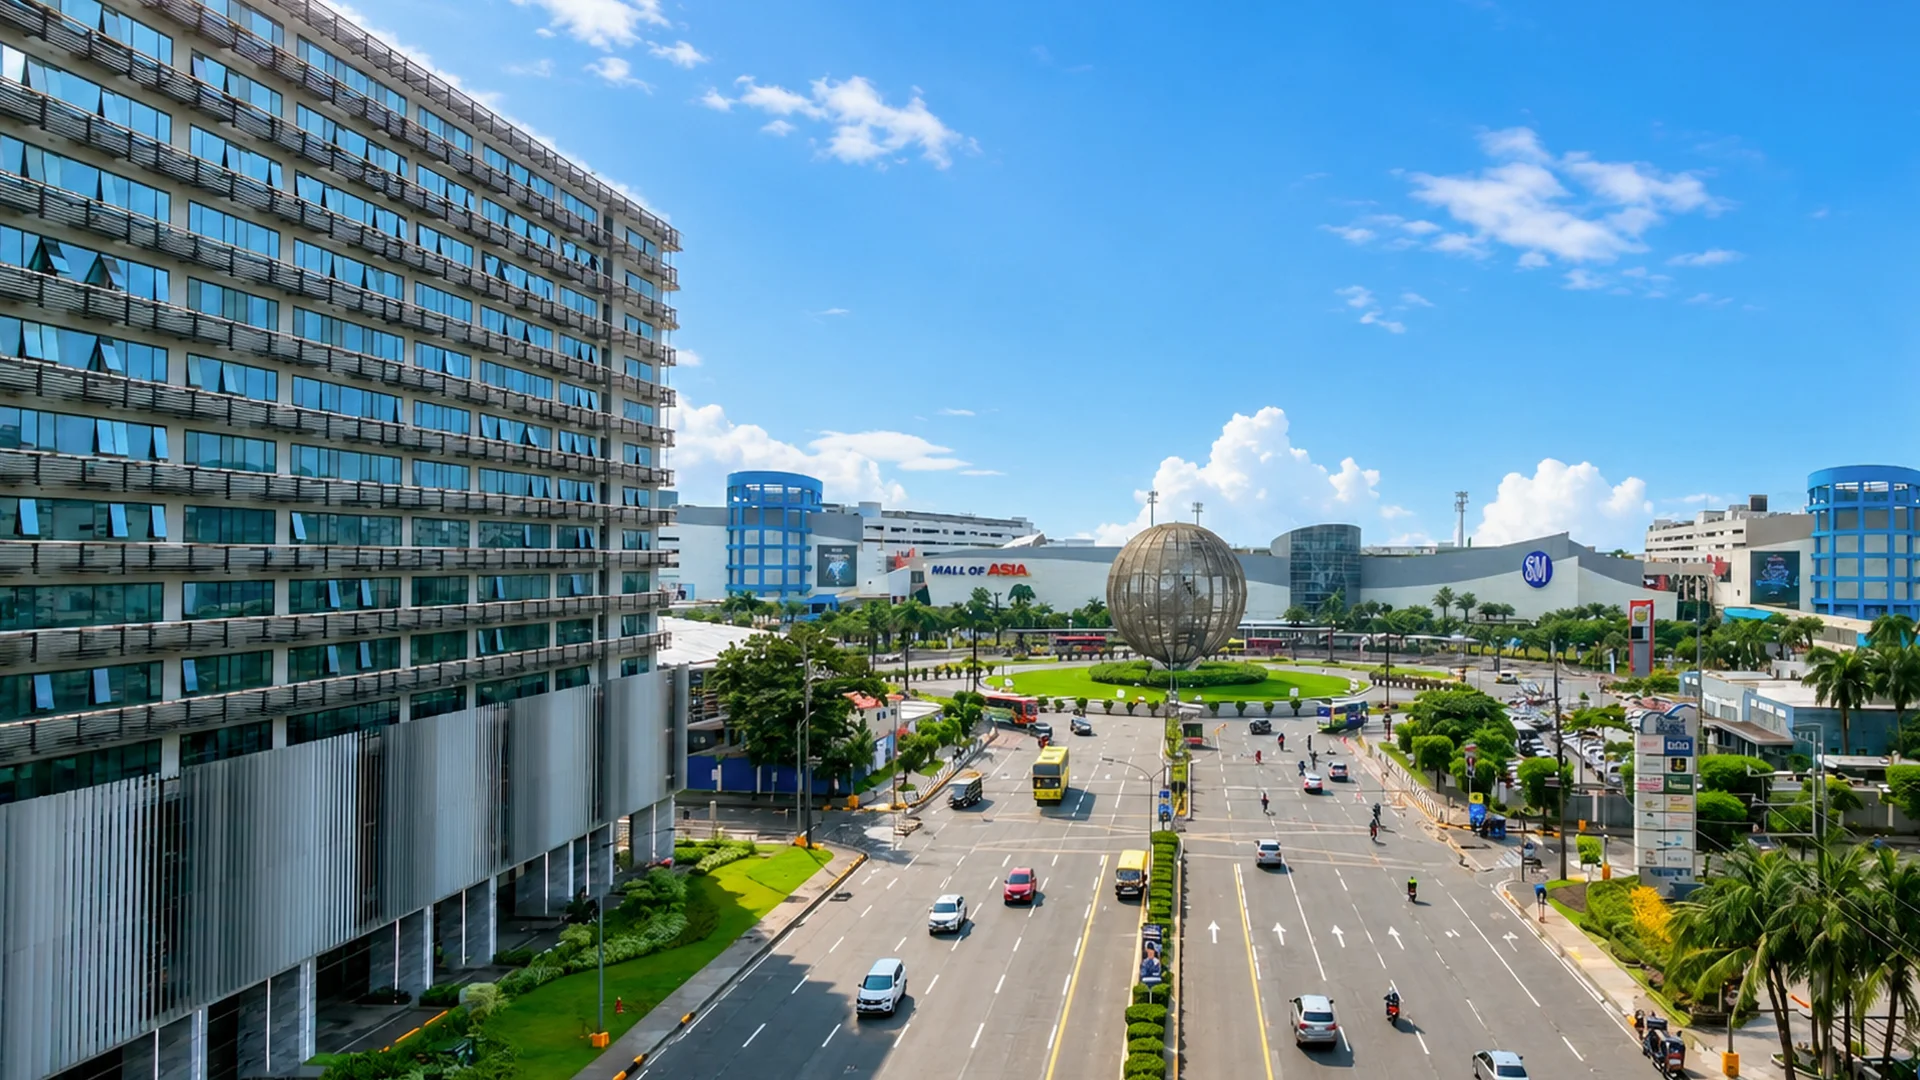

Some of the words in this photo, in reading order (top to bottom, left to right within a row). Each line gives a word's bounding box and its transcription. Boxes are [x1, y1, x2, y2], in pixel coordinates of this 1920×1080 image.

[931, 565, 966, 576] MALL
[968, 566, 985, 576] OF
[987, 563, 1028, 577] ASIA
[1525, 555, 1547, 582] SM
